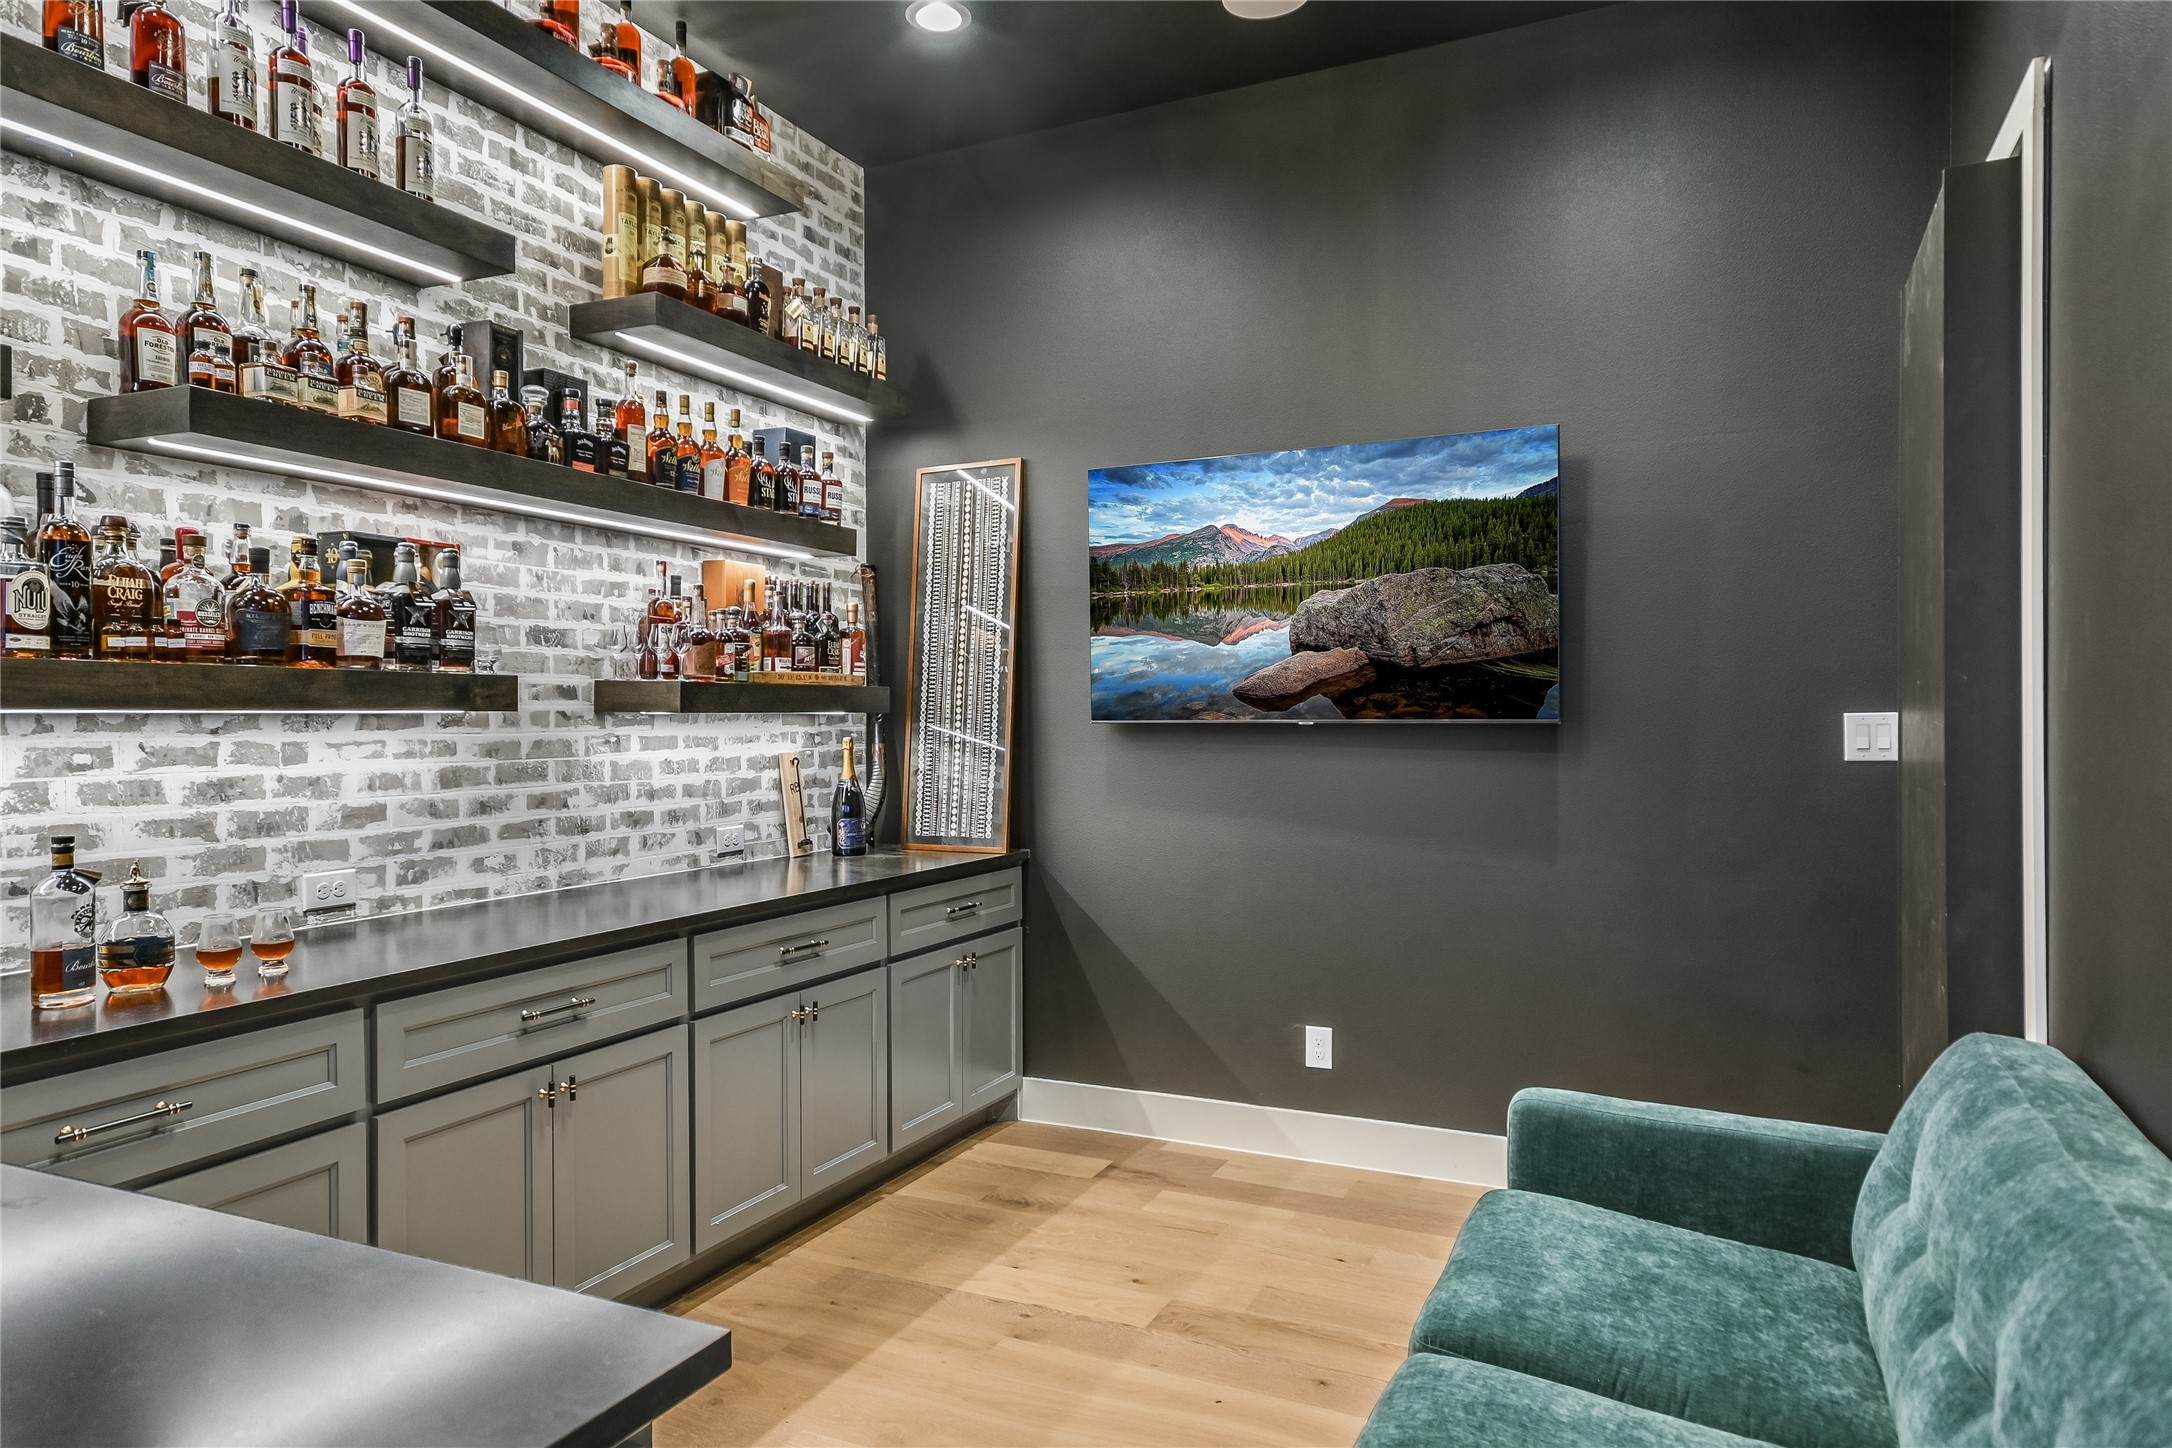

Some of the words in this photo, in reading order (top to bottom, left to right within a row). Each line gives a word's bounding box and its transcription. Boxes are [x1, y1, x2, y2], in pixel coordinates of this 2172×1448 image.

[156, 337, 169, 346] OLD
[71, 580, 80, 588] 10
[108, 574, 145, 589] ELIJAH
[107, 585, 144, 601] CRAIG
